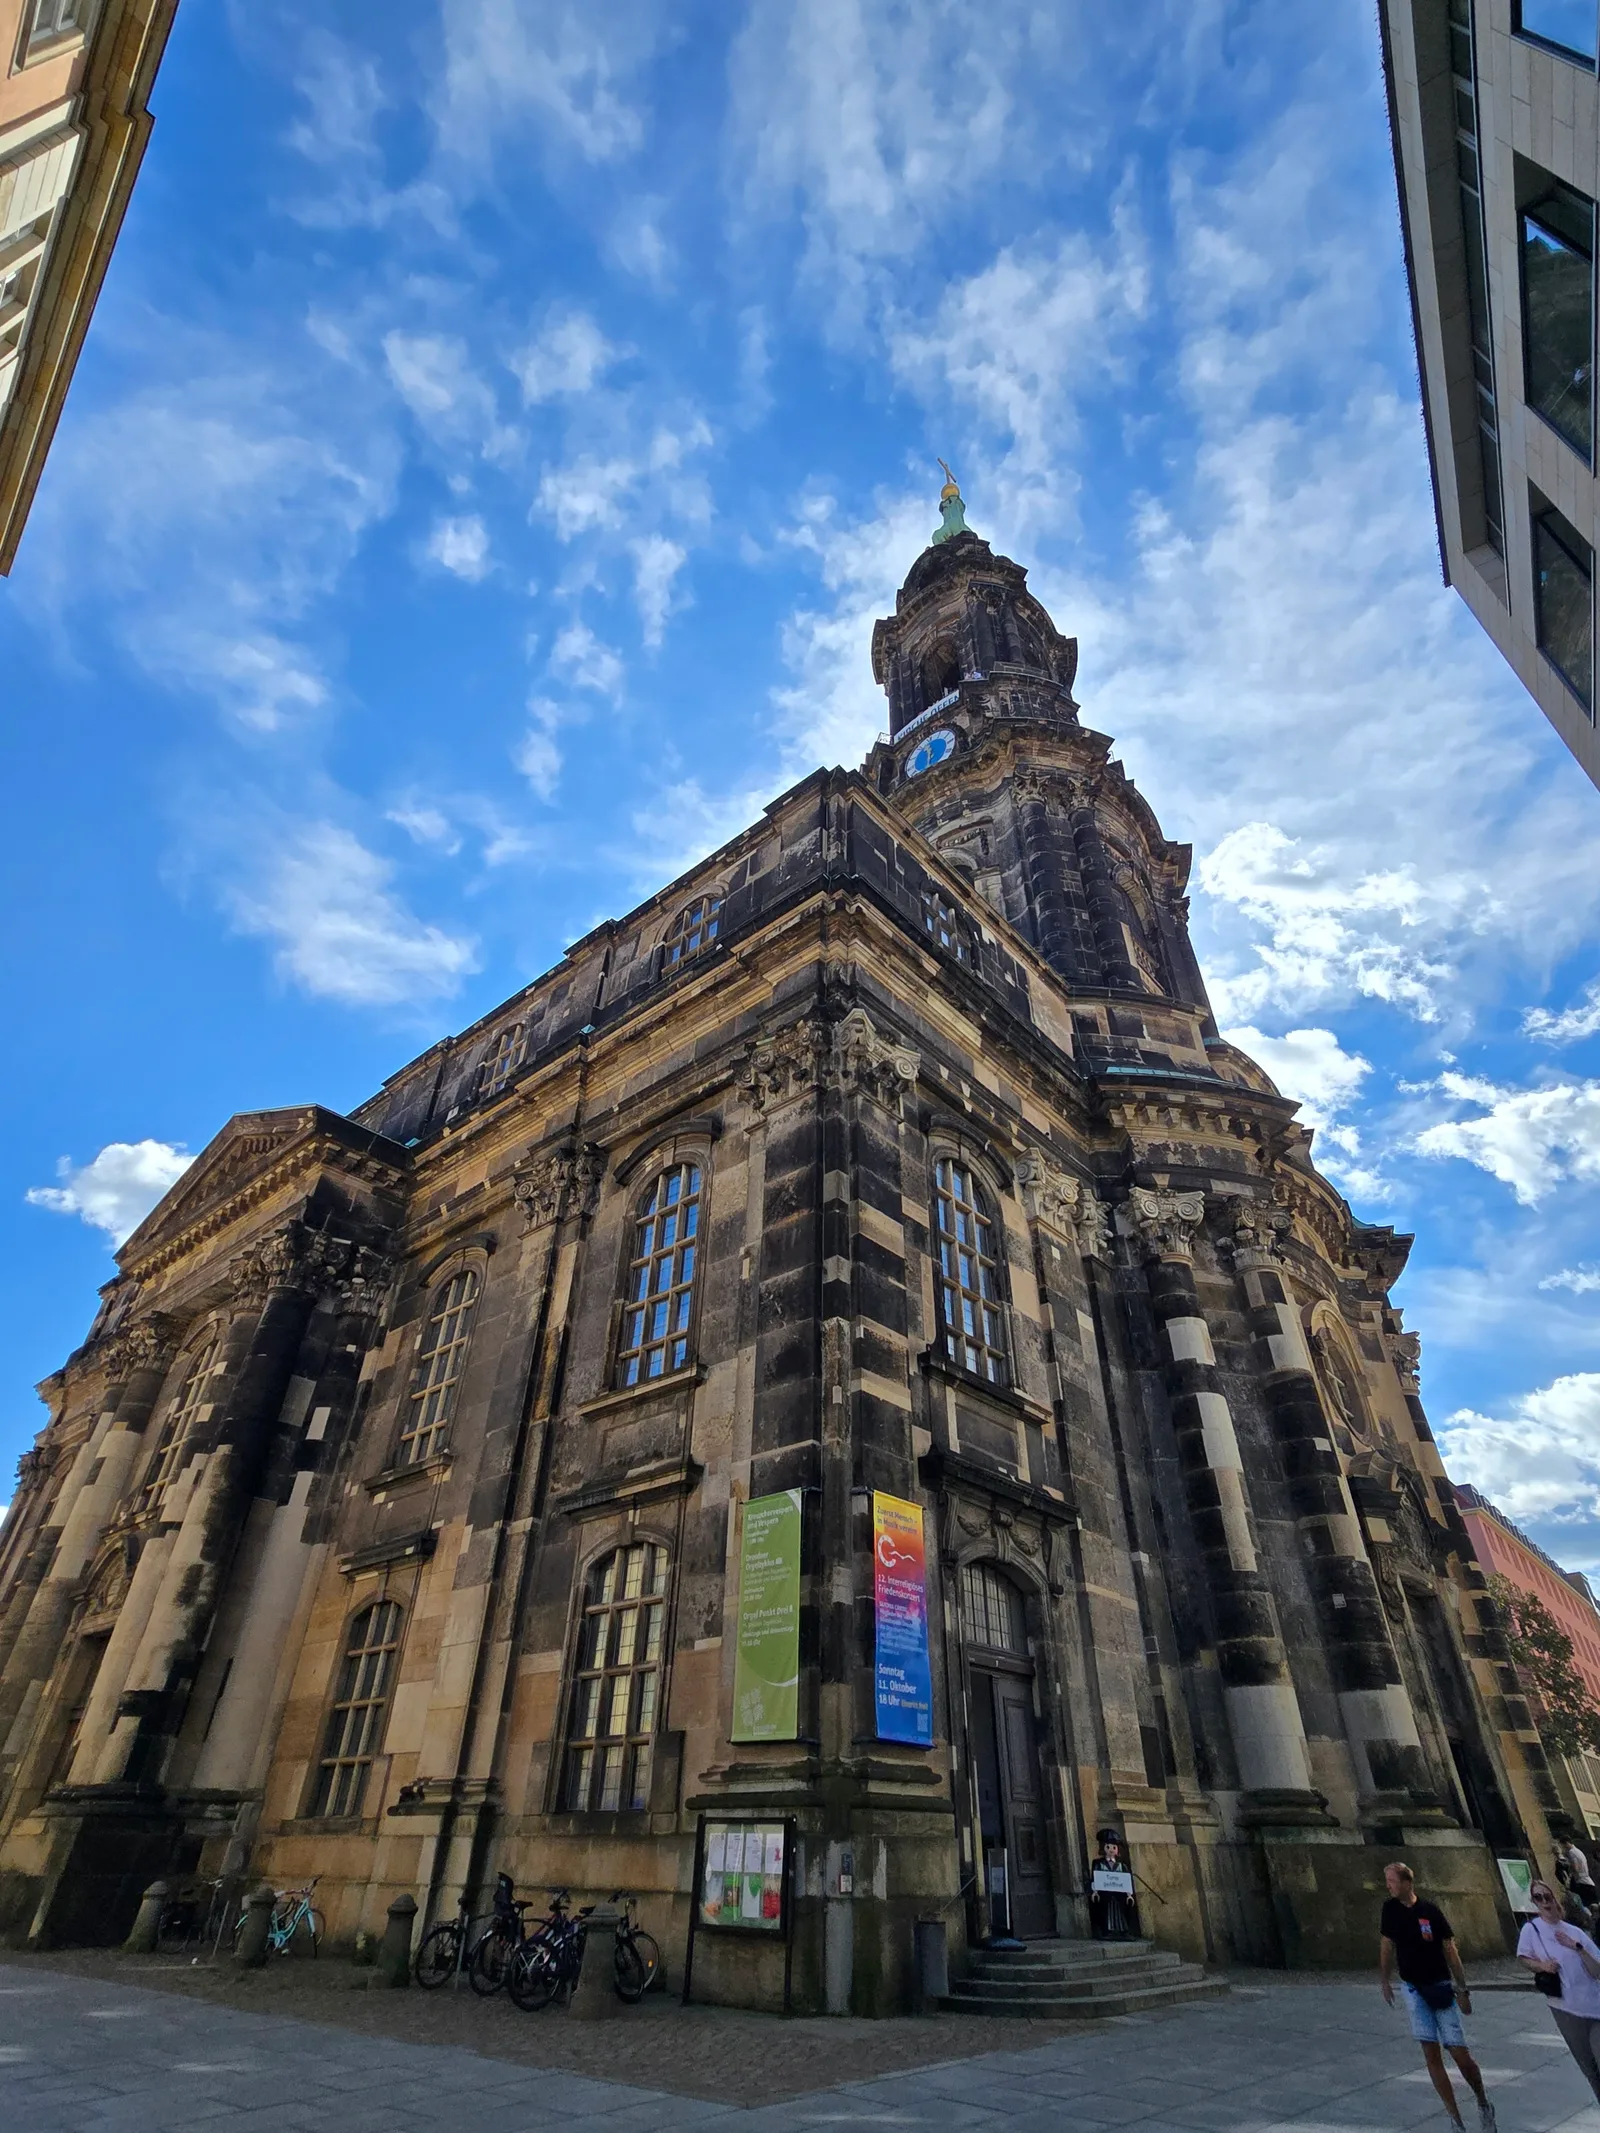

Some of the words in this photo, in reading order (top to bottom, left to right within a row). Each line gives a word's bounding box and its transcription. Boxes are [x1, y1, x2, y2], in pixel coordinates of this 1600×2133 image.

[878, 1574, 887, 1583] 12.
[878, 1584, 921, 1603] Friedenskonzert
[878, 1663, 905, 1681] Sonntag
[878, 1680, 889, 1690] 11.
[889, 1680, 917, 1695] Oktober
[878, 1693, 887, 1704] 18
[888, 1694, 901, 1706] Uhr
